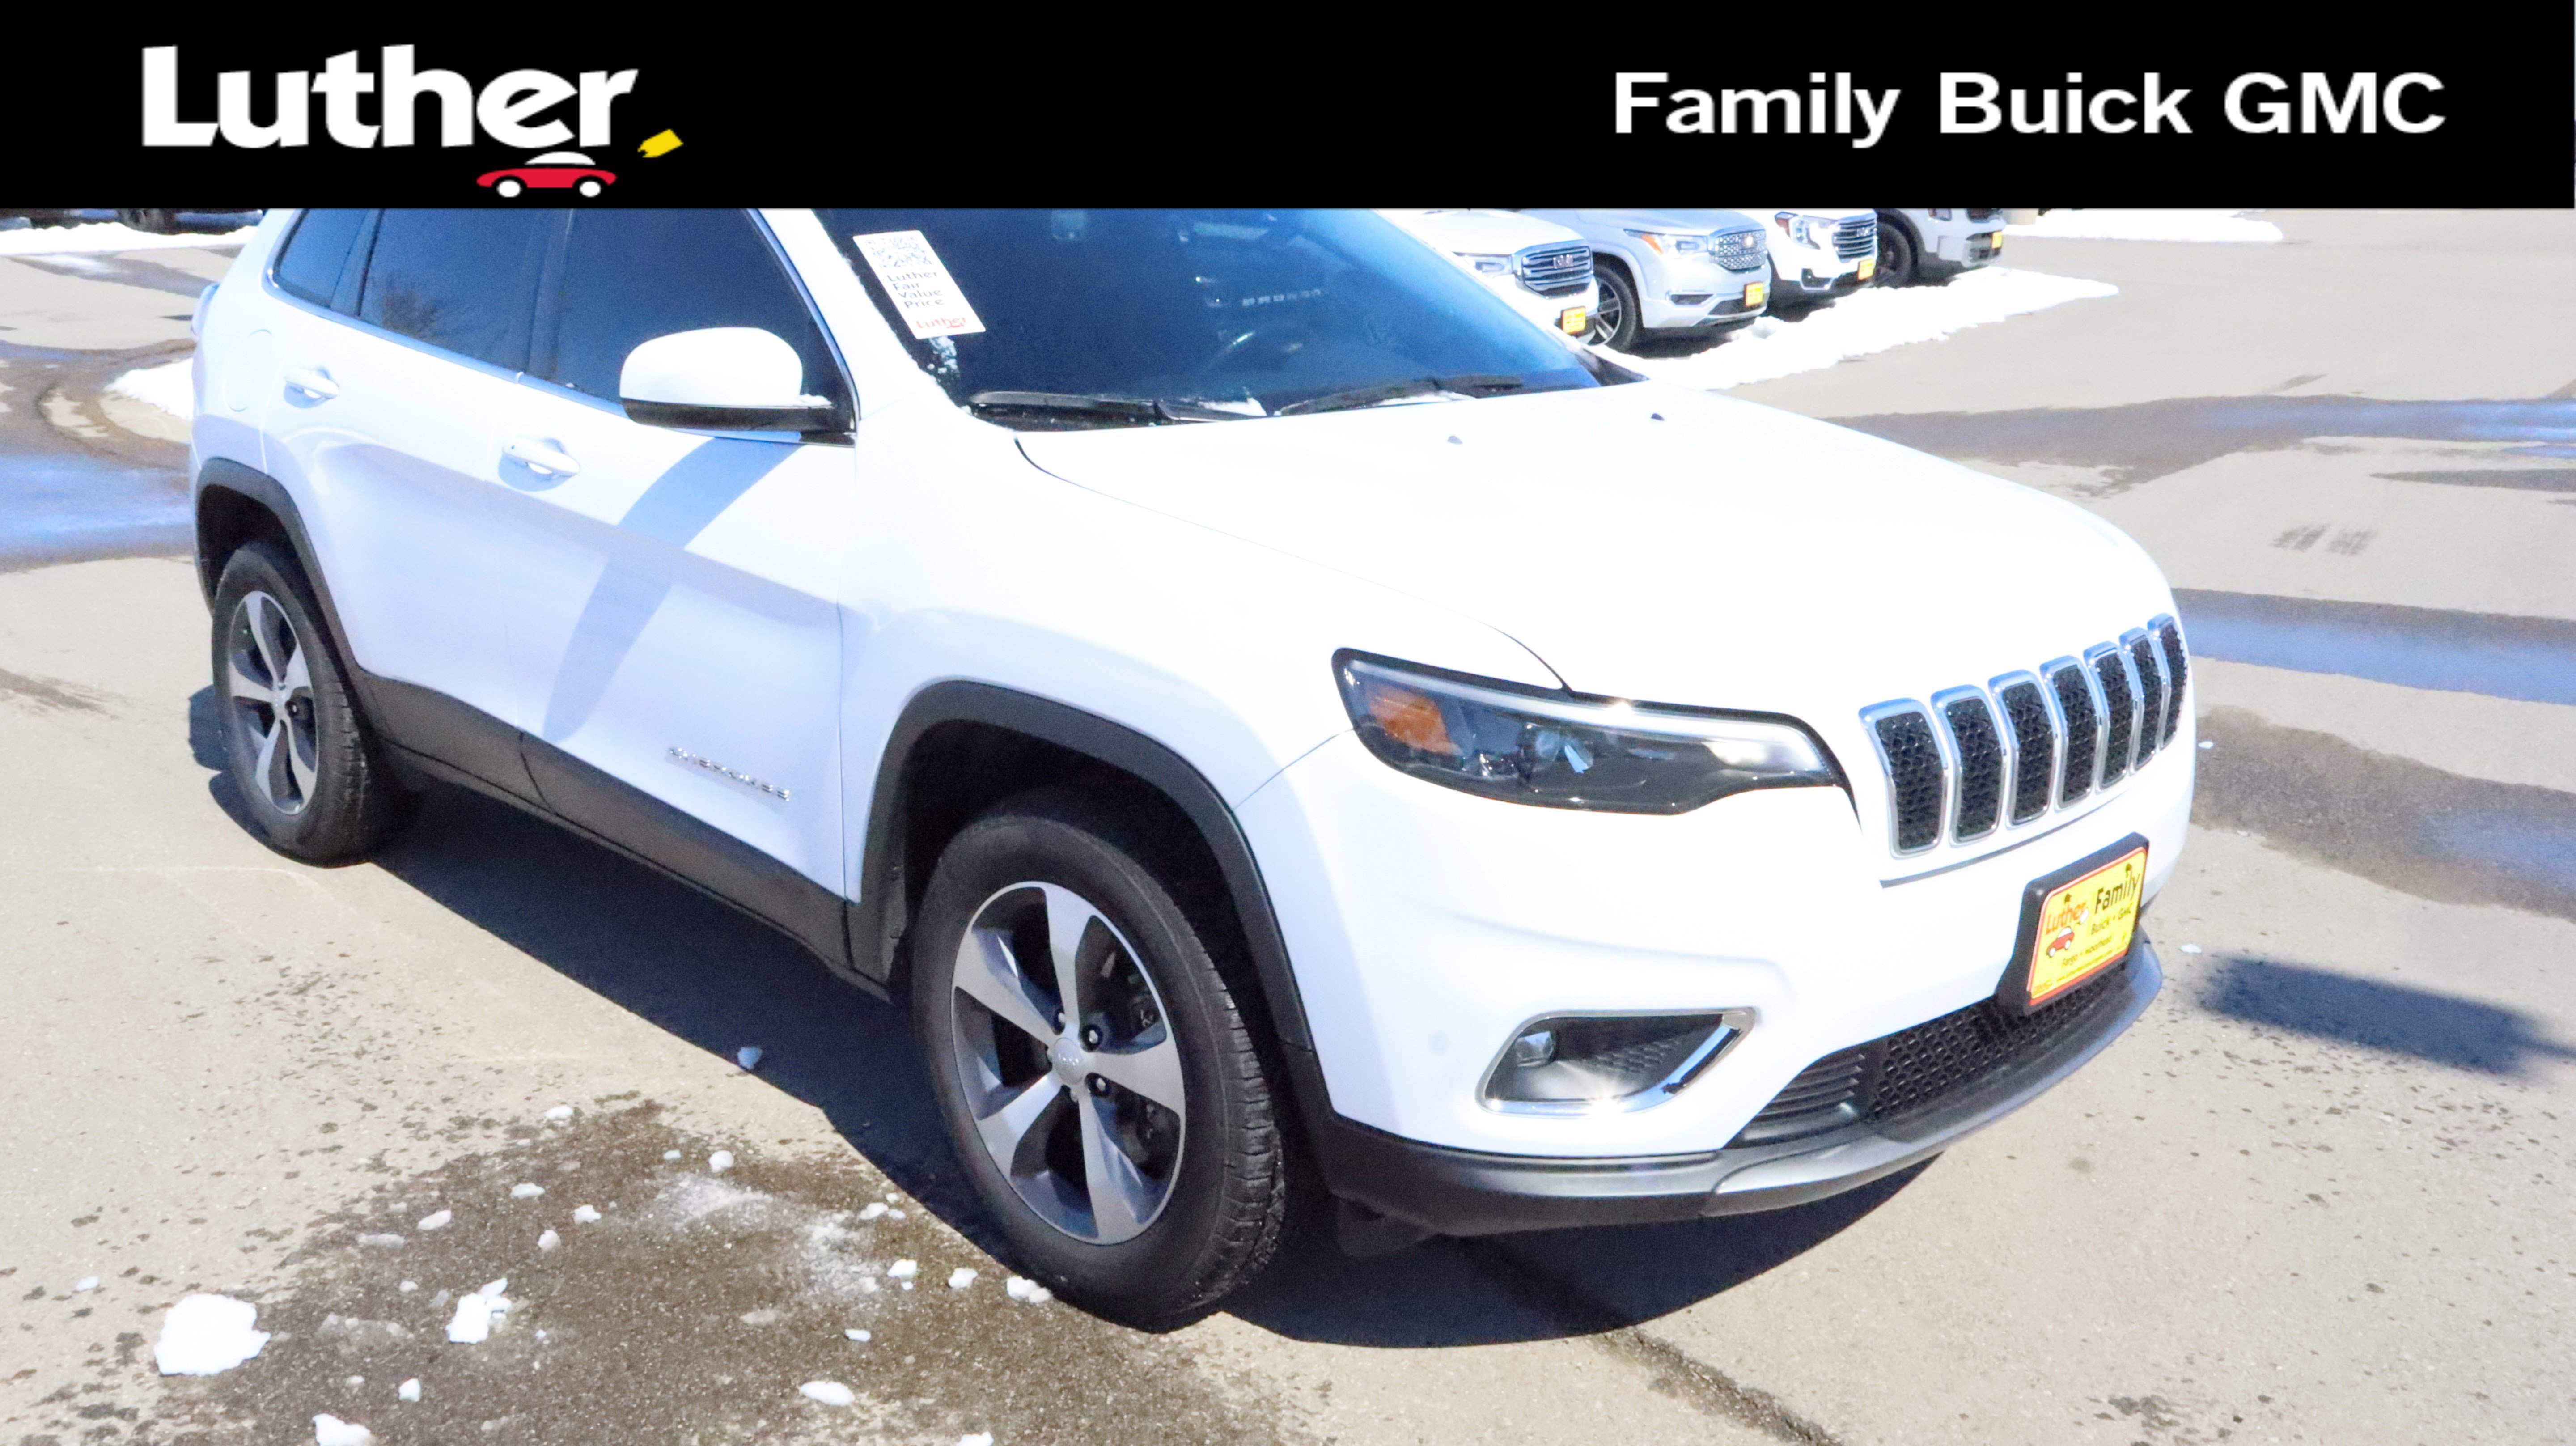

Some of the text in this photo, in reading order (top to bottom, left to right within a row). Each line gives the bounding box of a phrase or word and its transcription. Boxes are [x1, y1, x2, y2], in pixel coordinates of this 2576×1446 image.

[887, 271, 938, 282] Luther
[893, 282, 920, 291] Fair
[897, 289, 943, 299] Value
[903, 299, 944, 309] Price
[915, 317, 967, 328] Luther
[2094, 870, 2140, 915] Family
[2045, 901, 2087, 935] Luther
